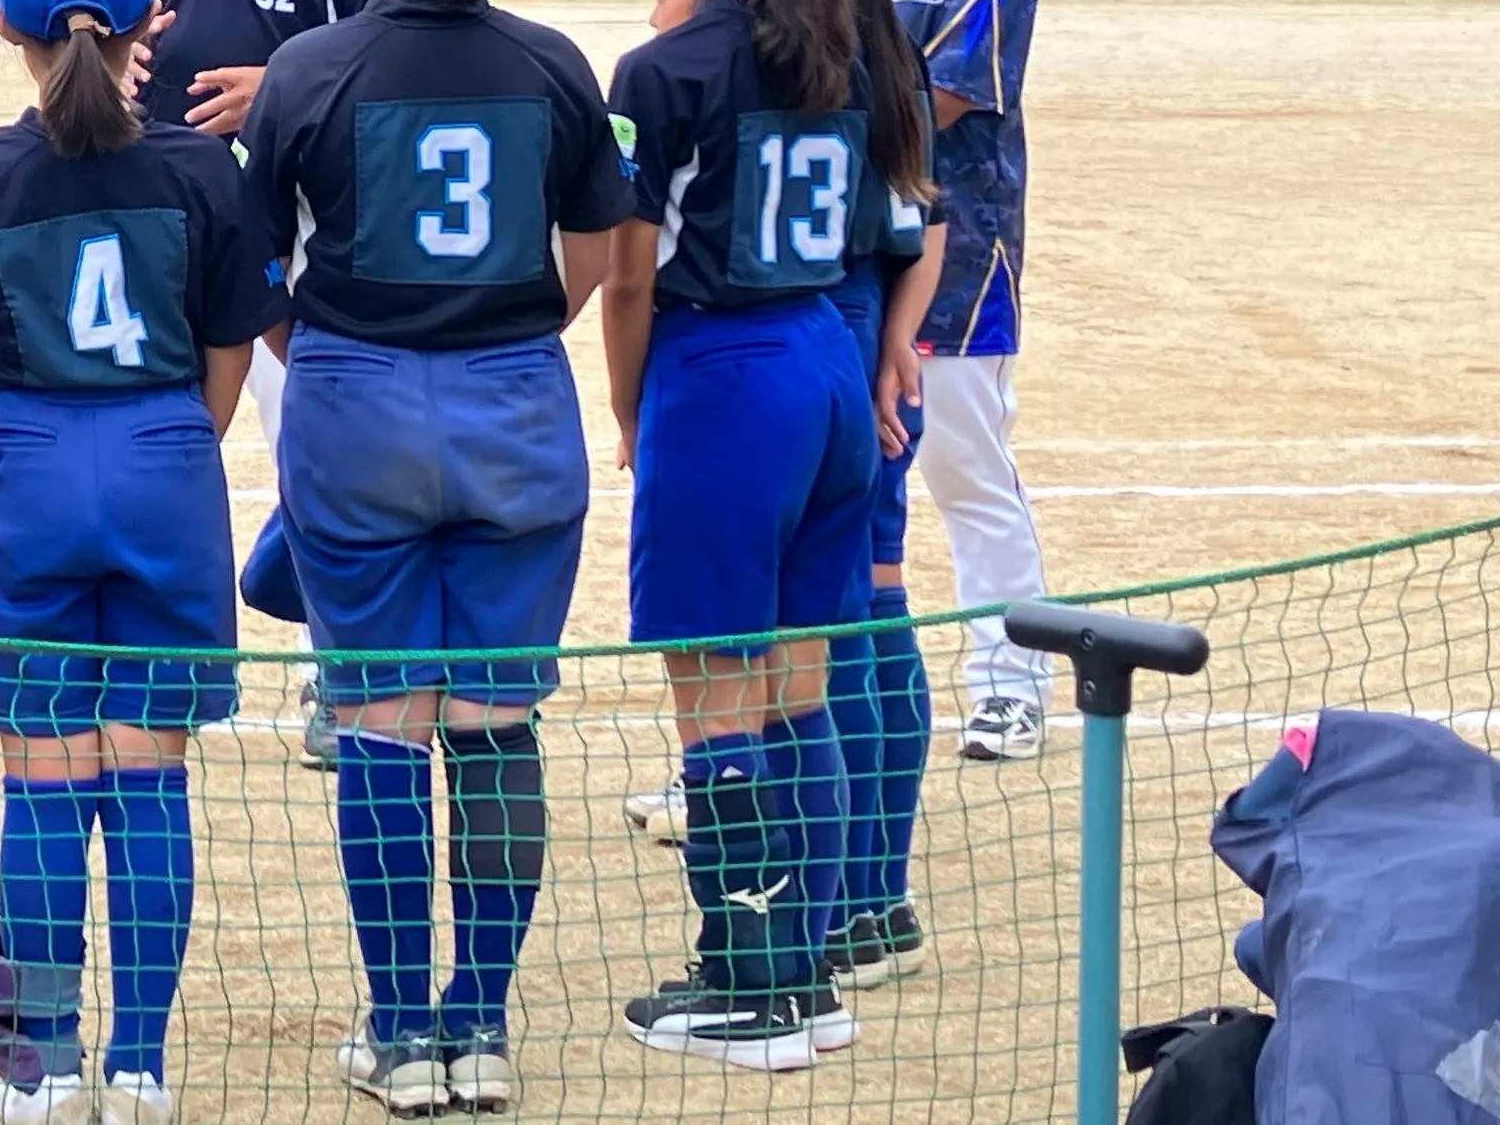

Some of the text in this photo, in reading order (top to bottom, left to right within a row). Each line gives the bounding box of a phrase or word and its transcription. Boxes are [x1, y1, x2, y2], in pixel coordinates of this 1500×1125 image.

[416, 123, 493, 259] 3
[757, 133, 850, 263] 13
[67, 233, 148, 368] 4
